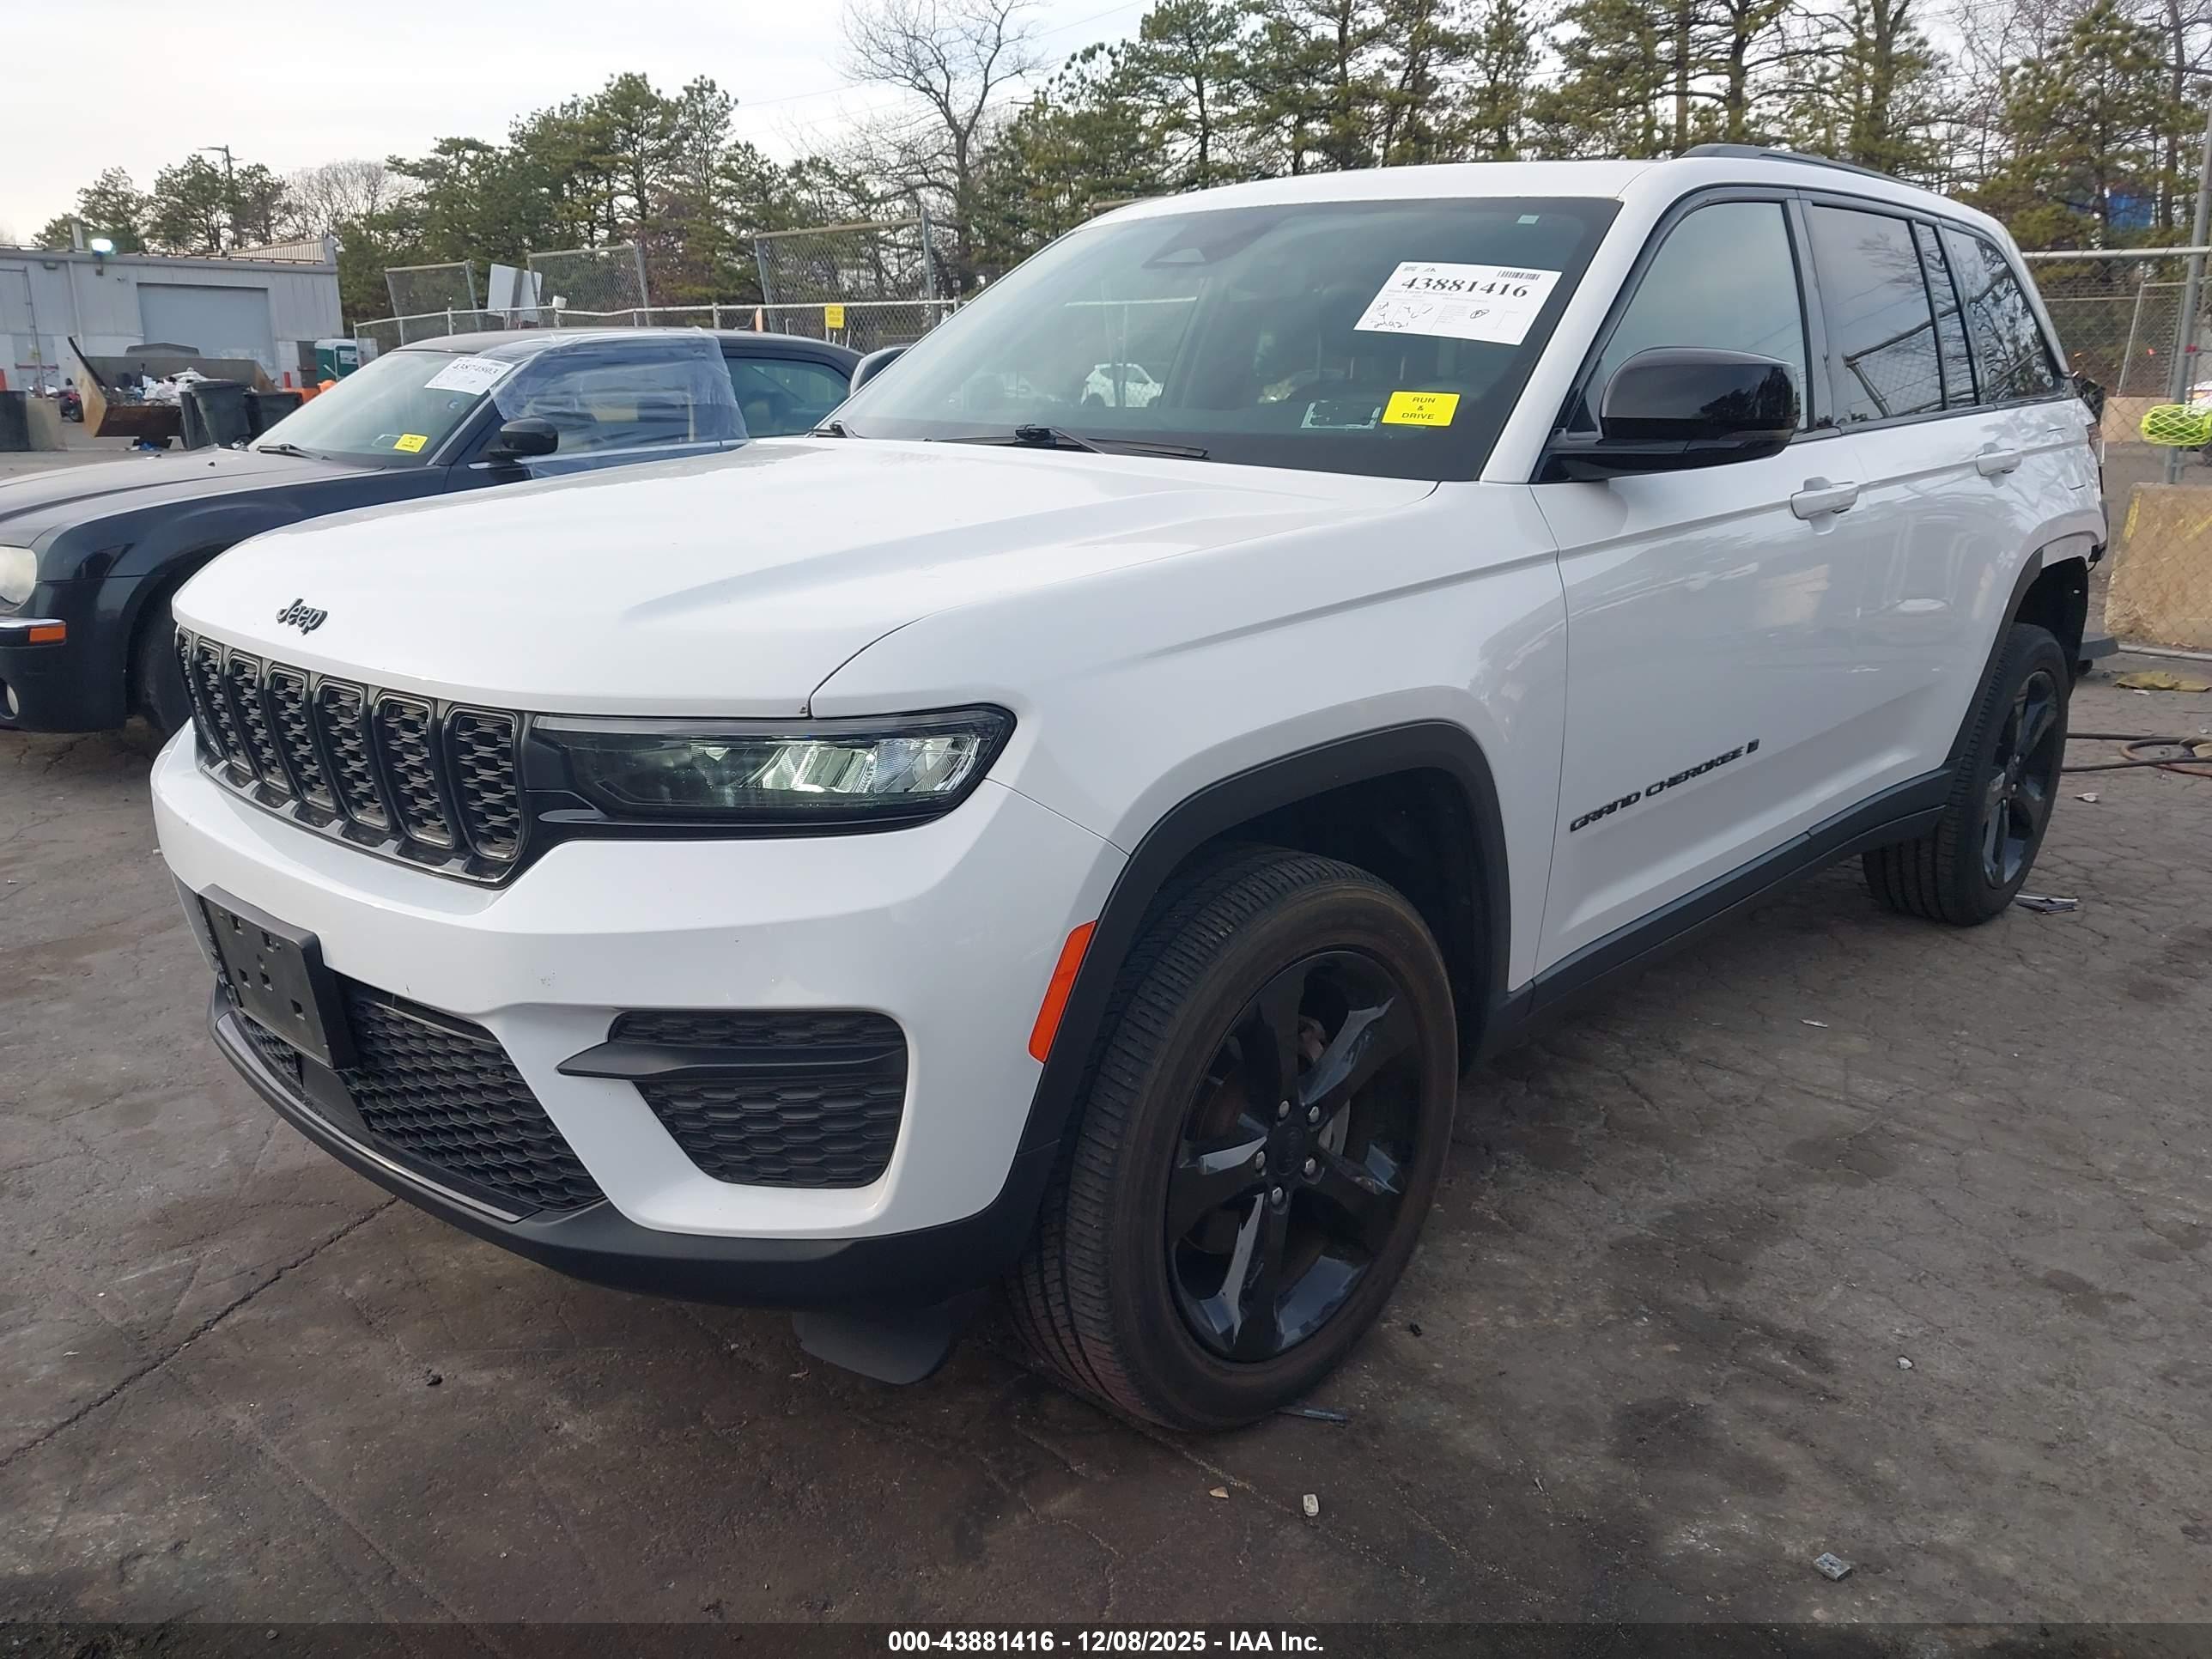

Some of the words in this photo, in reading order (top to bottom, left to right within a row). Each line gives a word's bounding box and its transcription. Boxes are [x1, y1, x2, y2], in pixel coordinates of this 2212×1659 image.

[1401, 276, 1530, 298] 43881416
[276, 598, 328, 636] Jeep
[1570, 791, 1642, 833] GRAND
[1645, 745, 1745, 797] CHEROKEE
